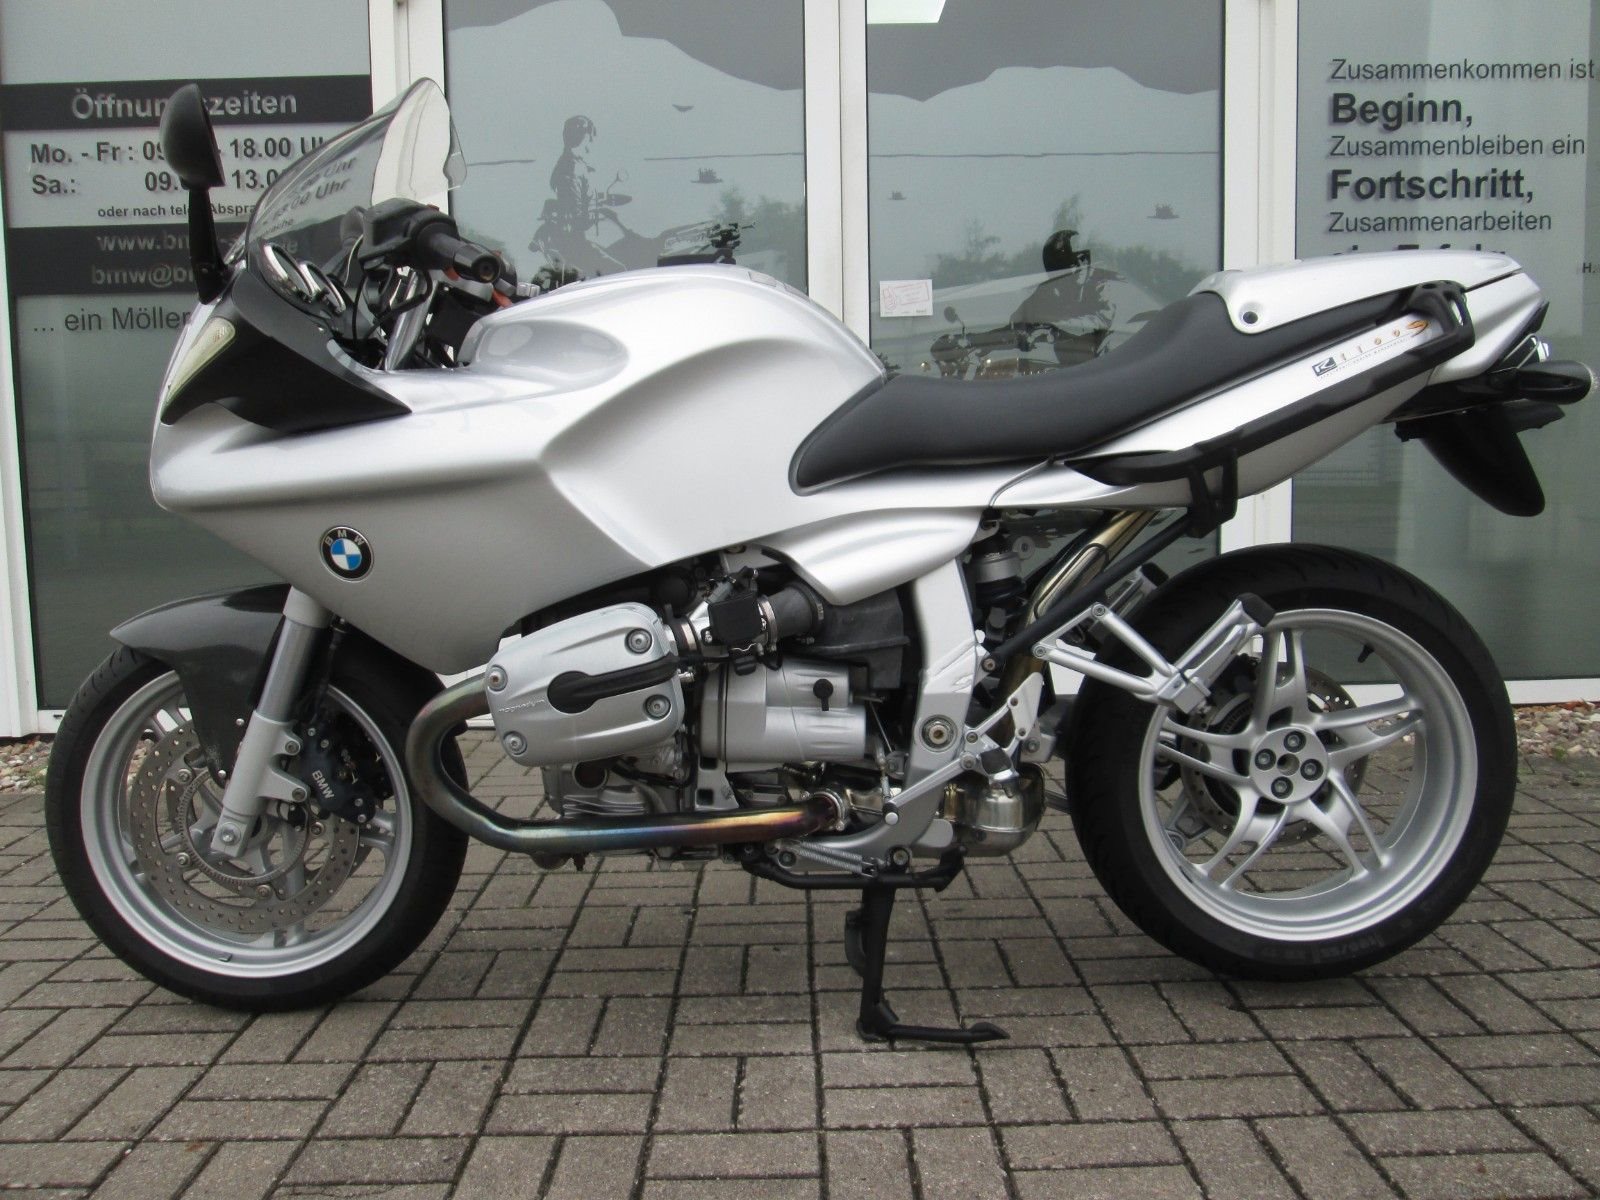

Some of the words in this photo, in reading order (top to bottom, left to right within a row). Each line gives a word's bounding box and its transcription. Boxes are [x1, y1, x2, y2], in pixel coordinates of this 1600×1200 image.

[1331, 59, 1561, 80] Zusammenkommen
[1569, 59, 1595, 79] ist
[72, 87, 297, 120] Öffnunzeiten
[1331, 92, 1473, 132] Beginn,
[31, 142, 73, 164] Mo.
[229, 137, 292, 158] 18.00
[1330, 135, 1543, 157] Zusammenbleiben
[1552, 134, 1586, 155] ein
[1331, 168, 1534, 204] Fortschritt,
[97, 205, 129, 218] oder
[133, 204, 166, 217] nach
[1329, 210, 1552, 232] Zusammenarbeiten
[65, 307, 102, 332] ein
[311, 769, 335, 799] BMW
